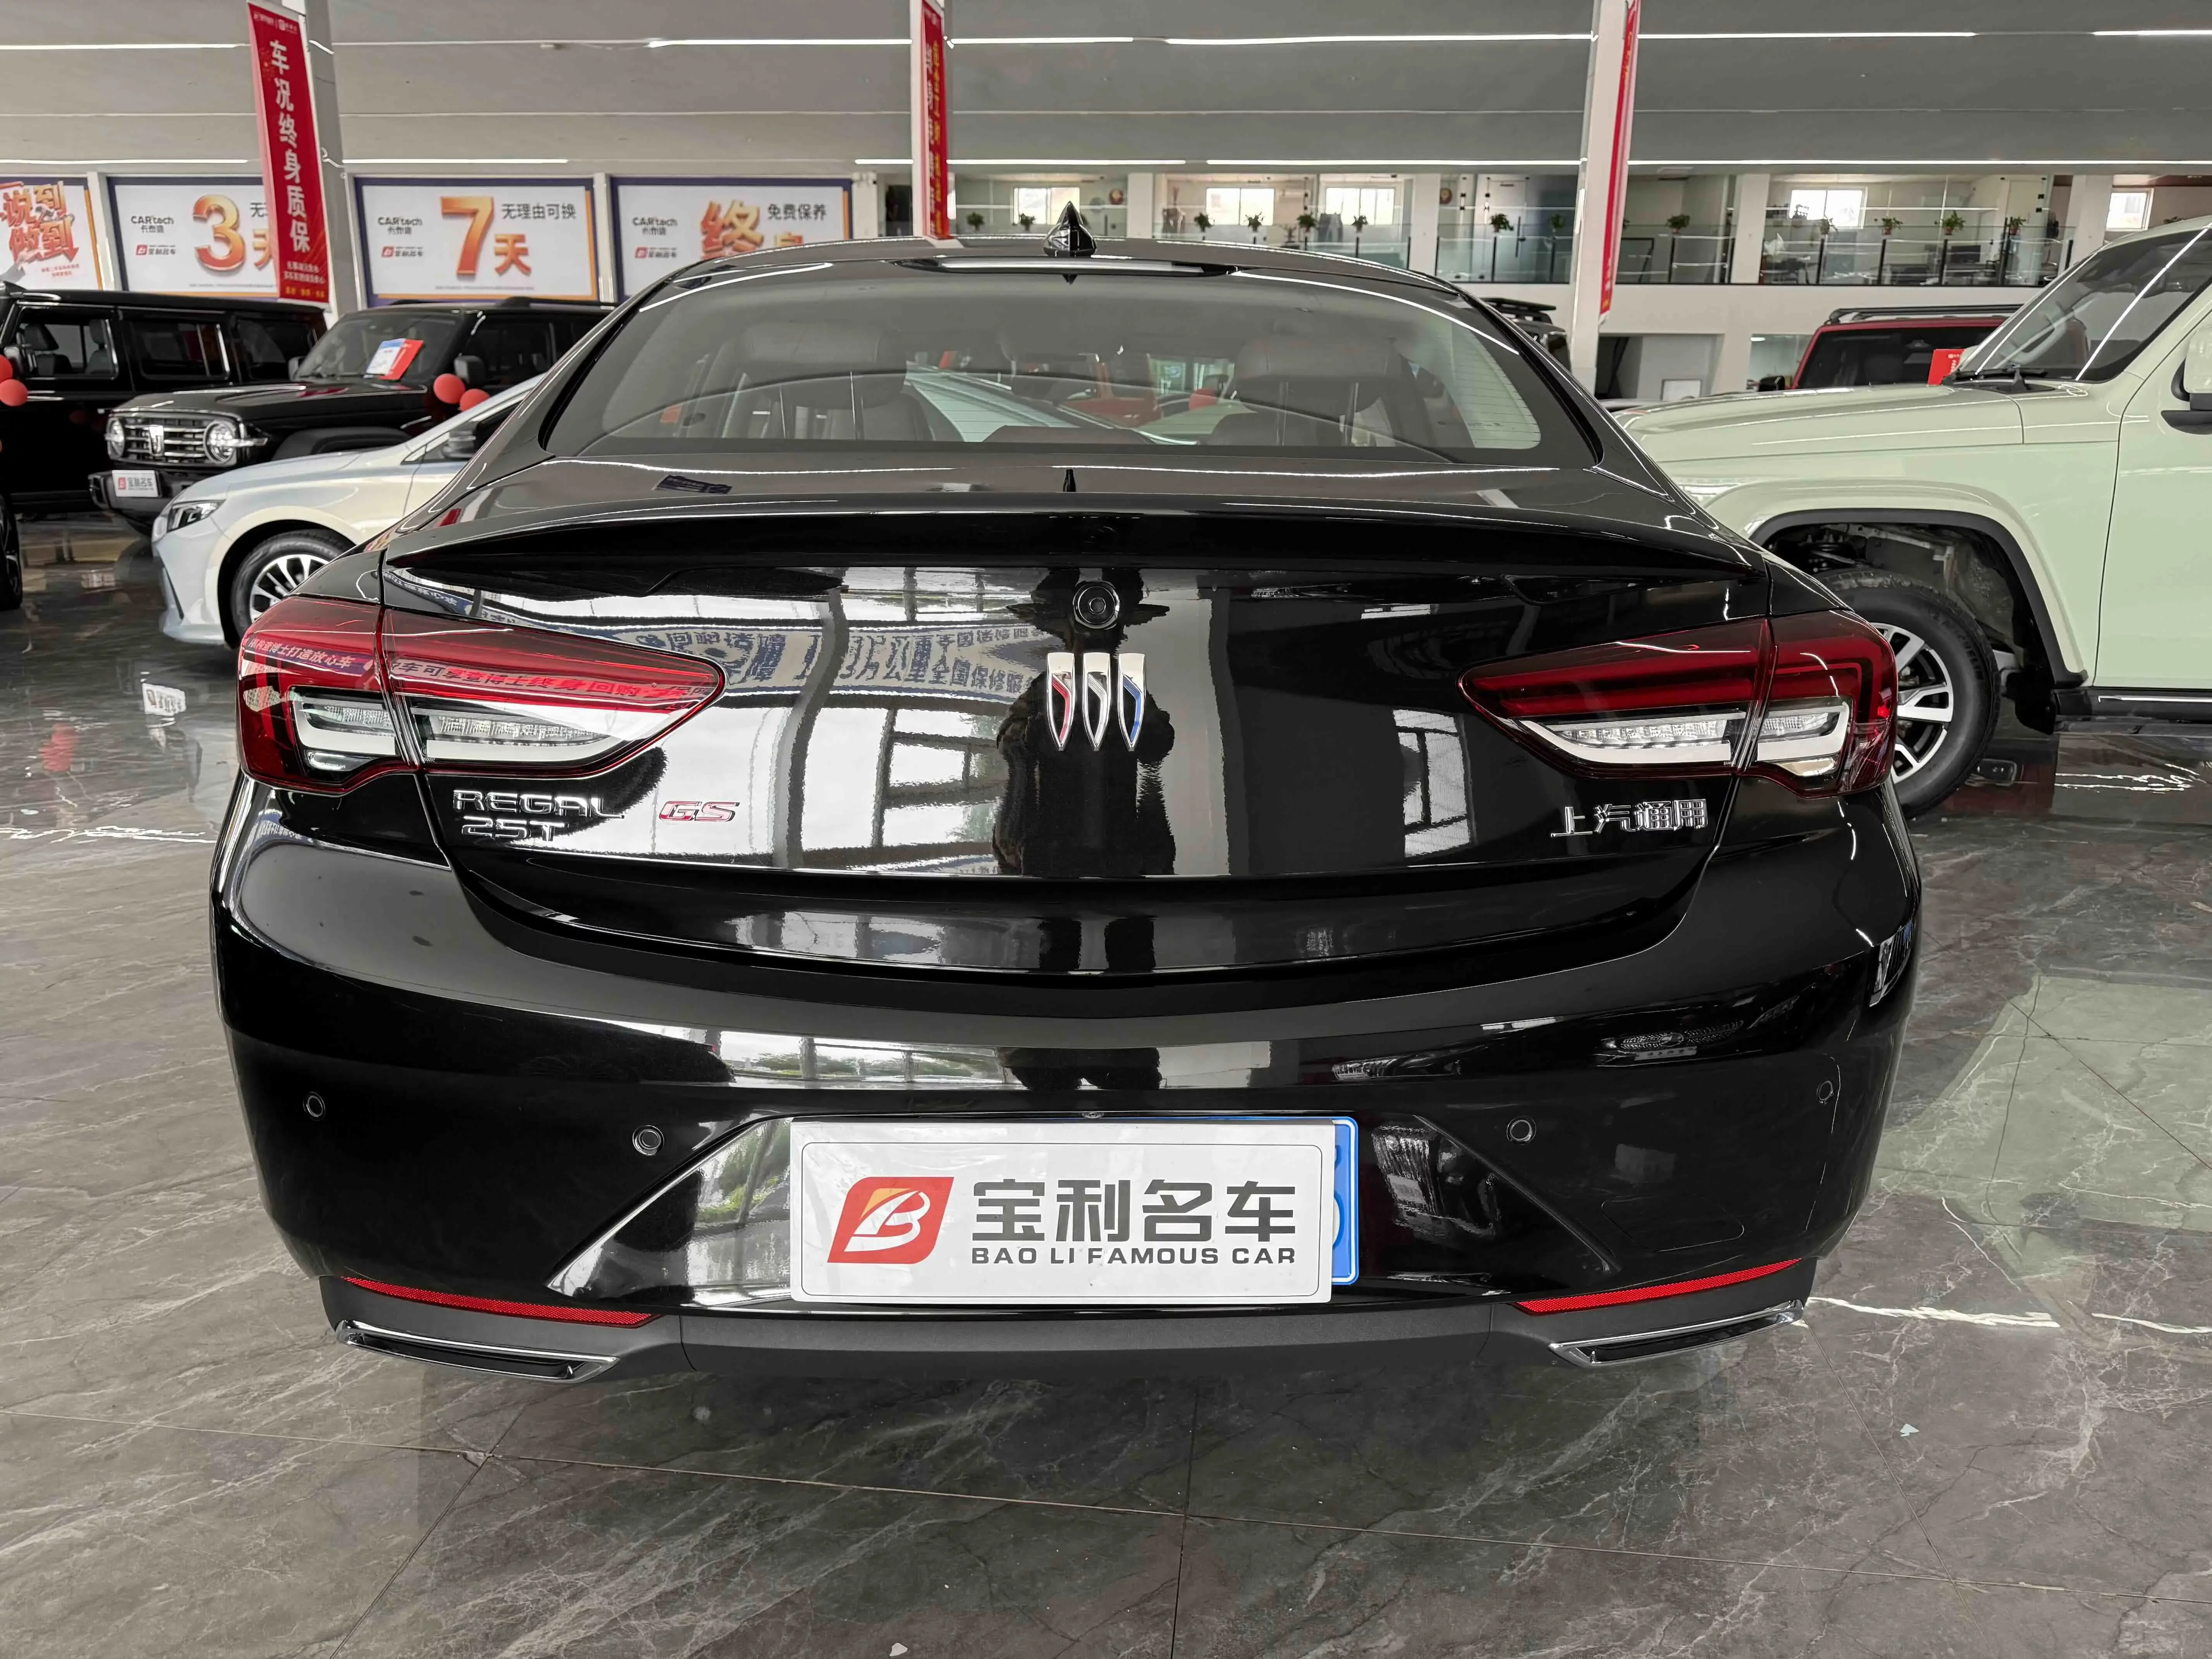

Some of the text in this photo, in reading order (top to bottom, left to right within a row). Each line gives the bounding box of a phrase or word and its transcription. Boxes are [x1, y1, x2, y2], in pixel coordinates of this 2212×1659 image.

[269, 40, 310, 254] 车况终身质保
[502, 203, 577, 220] 无理由可换
[767, 203, 827, 221] 免费保养
[452, 790, 625, 818] REGAL
[659, 801, 740, 822] GS
[462, 816, 565, 842] 25T
[1551, 799, 1708, 838] 上汽通用
[972, 1178, 1295, 1242] 宝利名车
[972, 1247, 1295, 1264] BAO LI FAMOUS CAR
